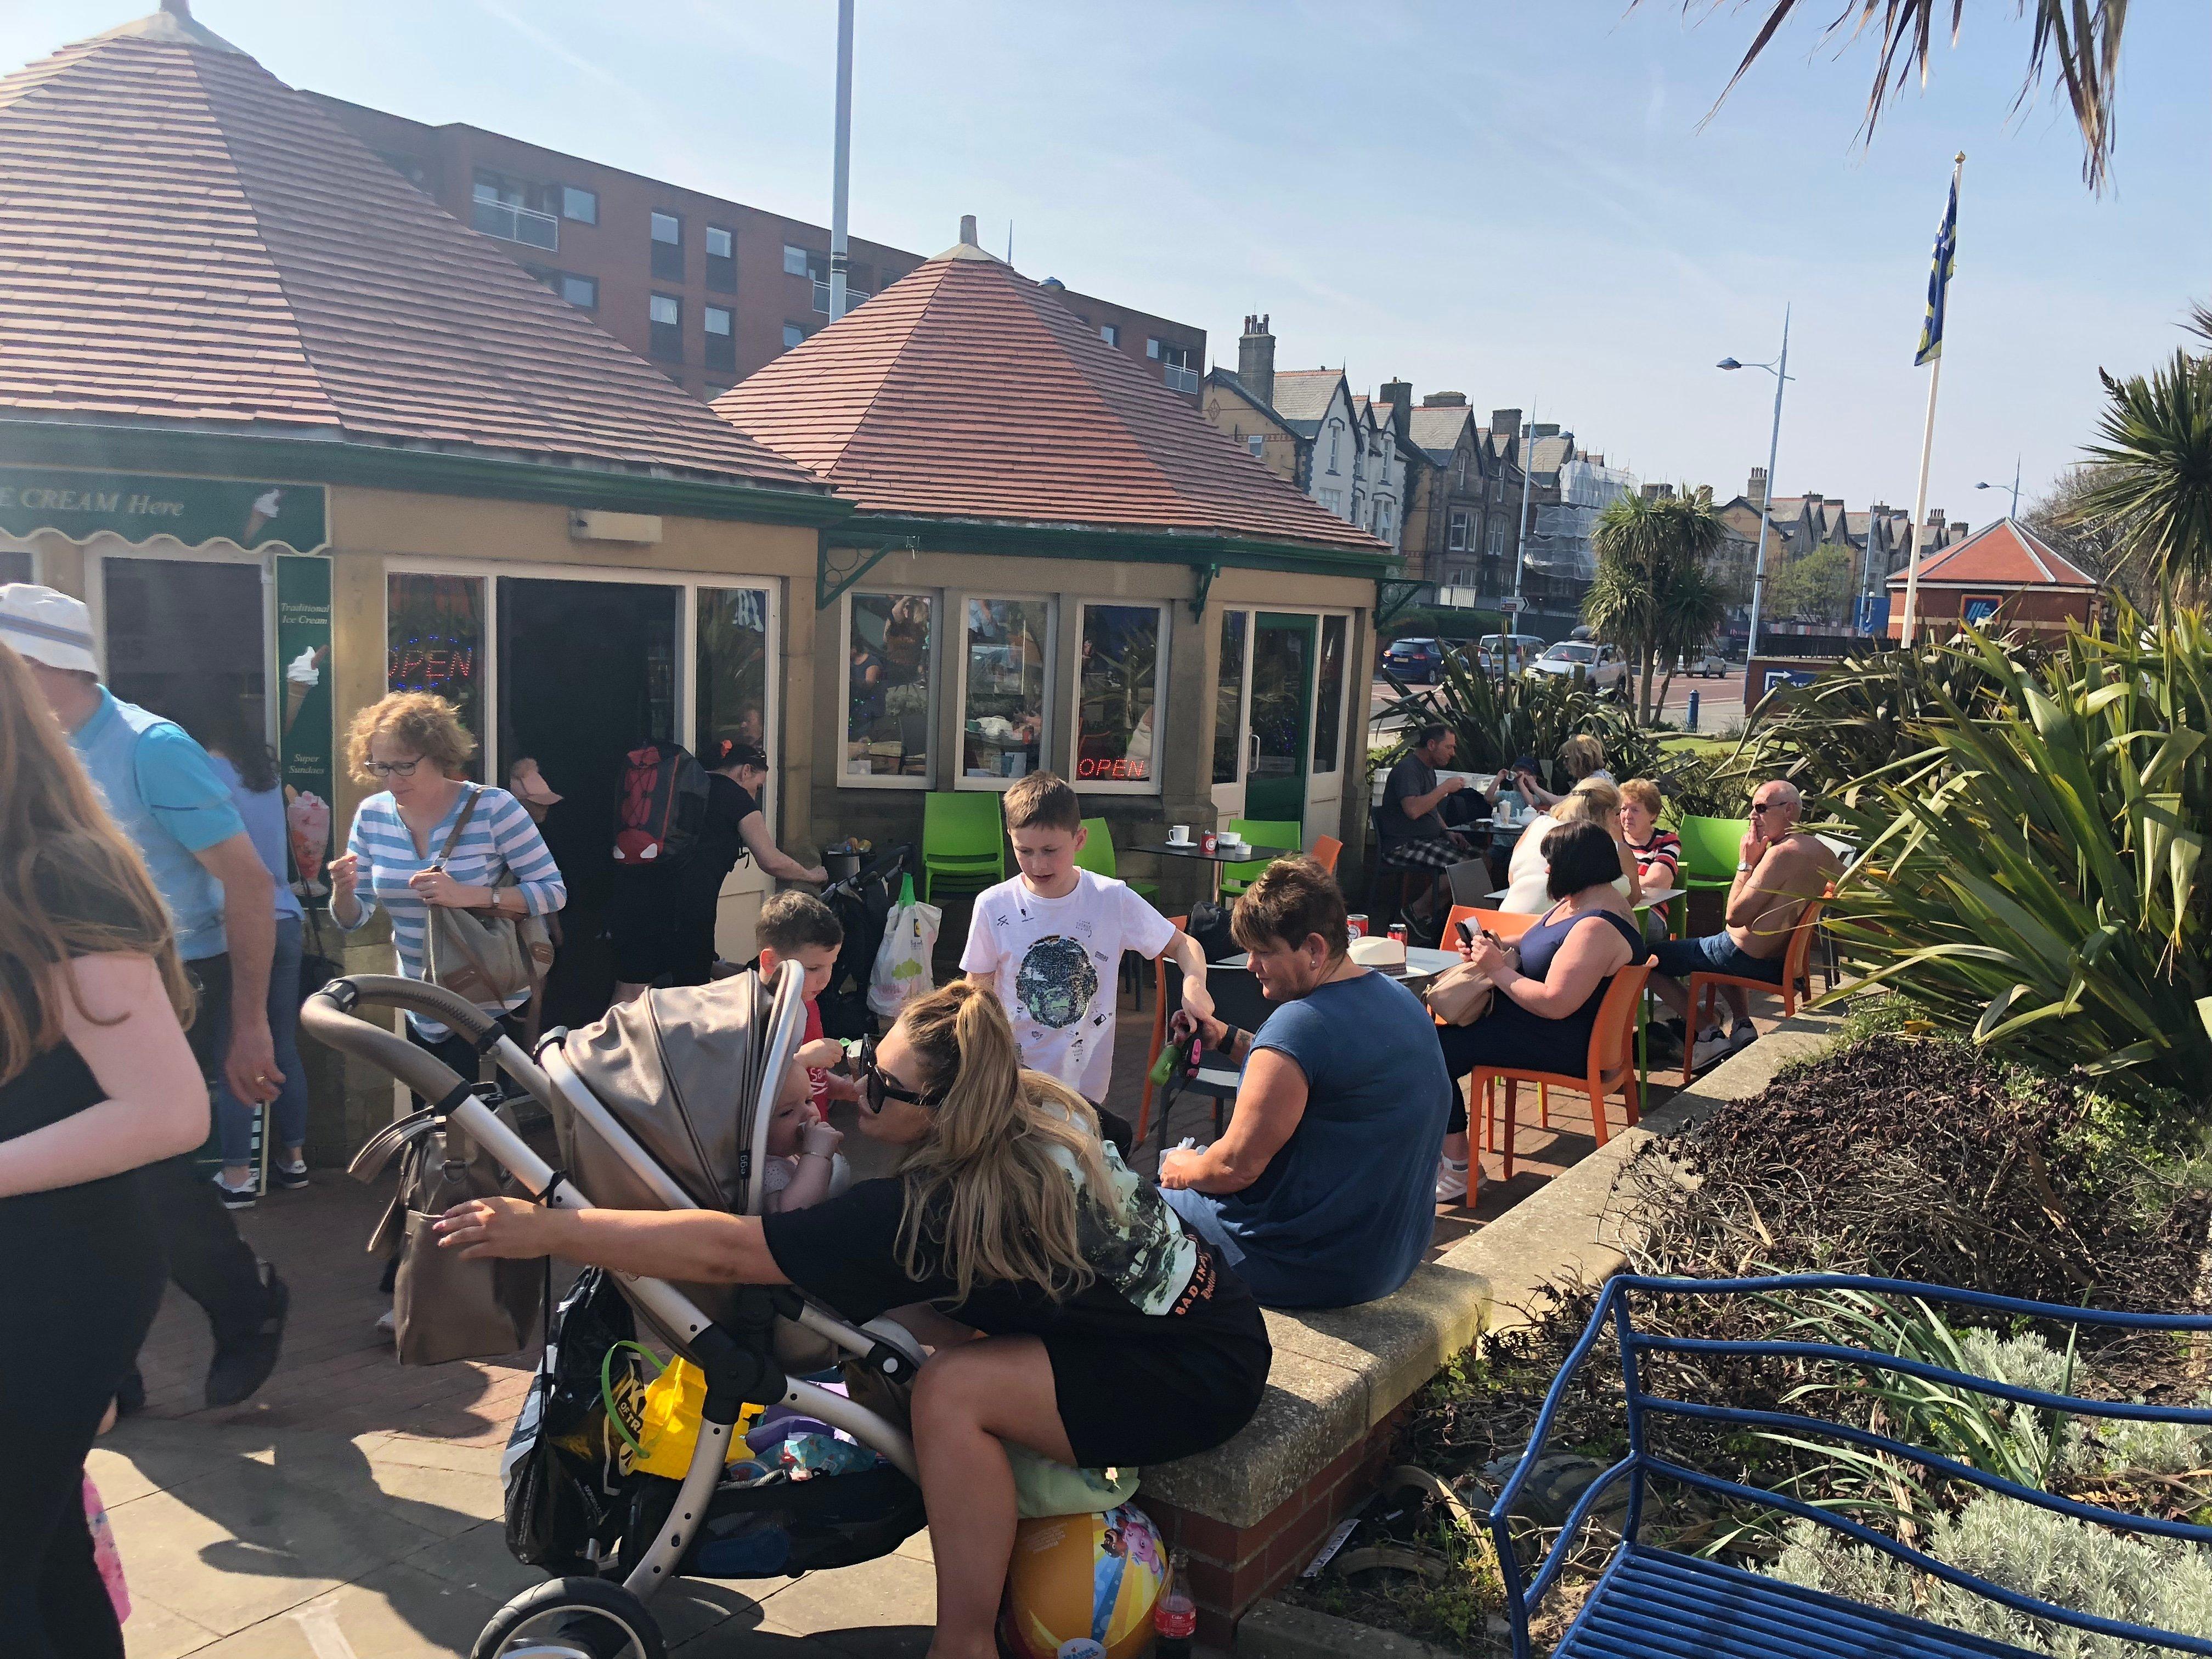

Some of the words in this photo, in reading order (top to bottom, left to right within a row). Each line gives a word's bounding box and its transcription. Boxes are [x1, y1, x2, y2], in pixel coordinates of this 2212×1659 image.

[20, 489, 120, 512] CREAM
[128, 495, 185, 516] Here
[281, 603, 330, 613] Traditional
[299, 616, 328, 624] Cream
[294, 754, 319, 764] Super
[289, 766, 325, 774] Sundaes
[1079, 758, 1144, 776] OPEN
[740, 1155, 748, 1175] egg
[1175, 1285, 1199, 1315] BAD
[620, 1402, 630, 1414] OF
